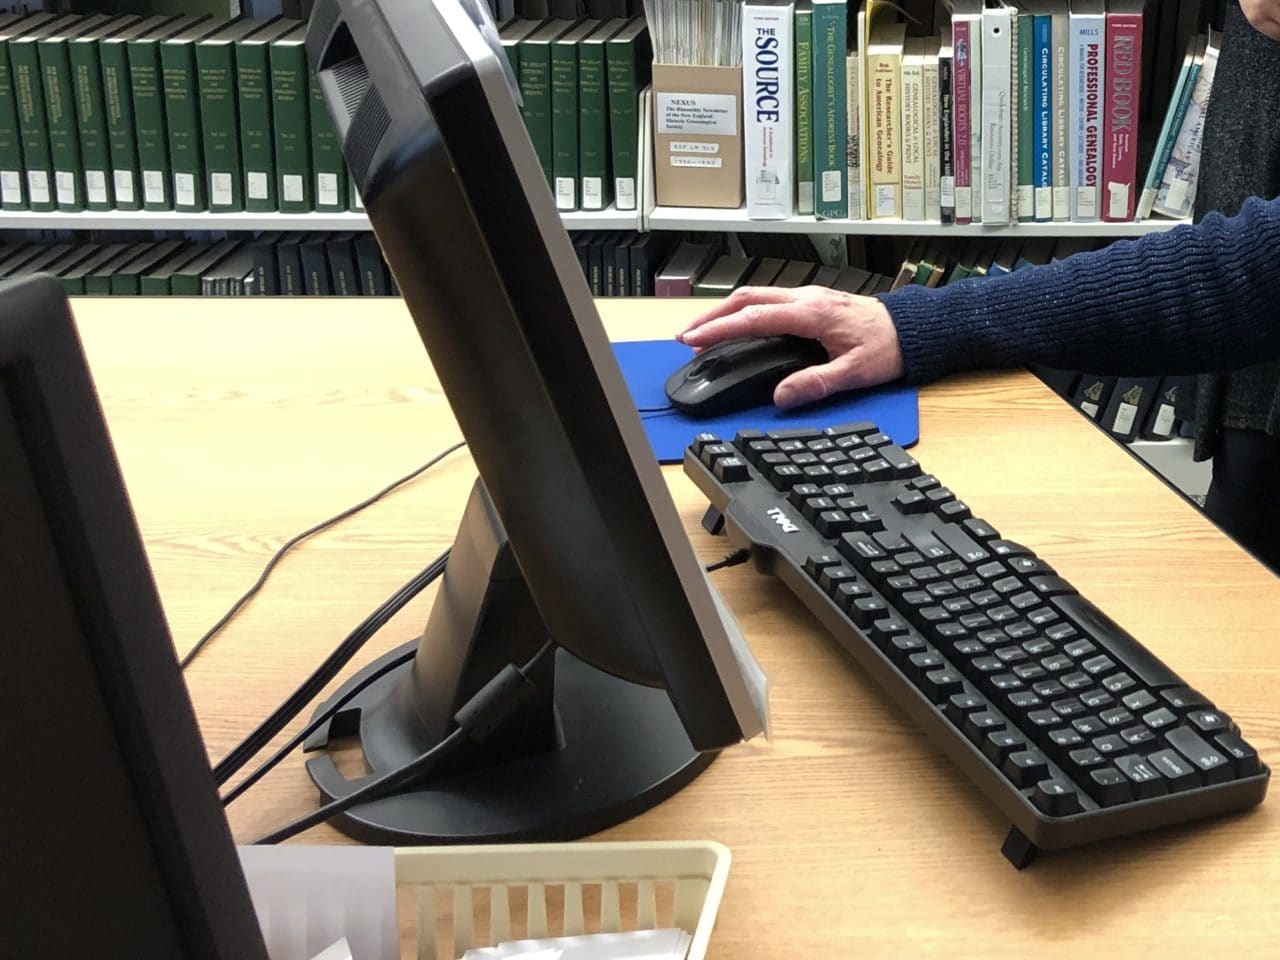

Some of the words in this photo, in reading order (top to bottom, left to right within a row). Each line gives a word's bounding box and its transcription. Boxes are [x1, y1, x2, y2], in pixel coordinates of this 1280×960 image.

[756, 27, 776, 36] THE
[1079, 28, 1099, 36] MILLS
[798, 41, 810, 84] FAMILY
[1114, 35, 1134, 74] RED
[755, 36, 780, 123] SOURCE
[876, 78, 883, 87] to
[885, 78, 893, 93] The
[958, 68, 966, 102] VIRTUAL
[1041, 47, 1049, 108] CIRCULATING
[1087, 43, 1098, 123] PROFESSIONAL
[798, 86, 811, 164] ASSOCIATIONS
[885, 95, 893, 148] Researcher's
[958, 104, 966, 132] ROOTS
[1112, 77, 1134, 132] BOOK
[875, 130, 884, 172] Genealogy
[1041, 111, 1049, 149] LIBRARY
[1086, 127, 1097, 187] GENEALOGY
